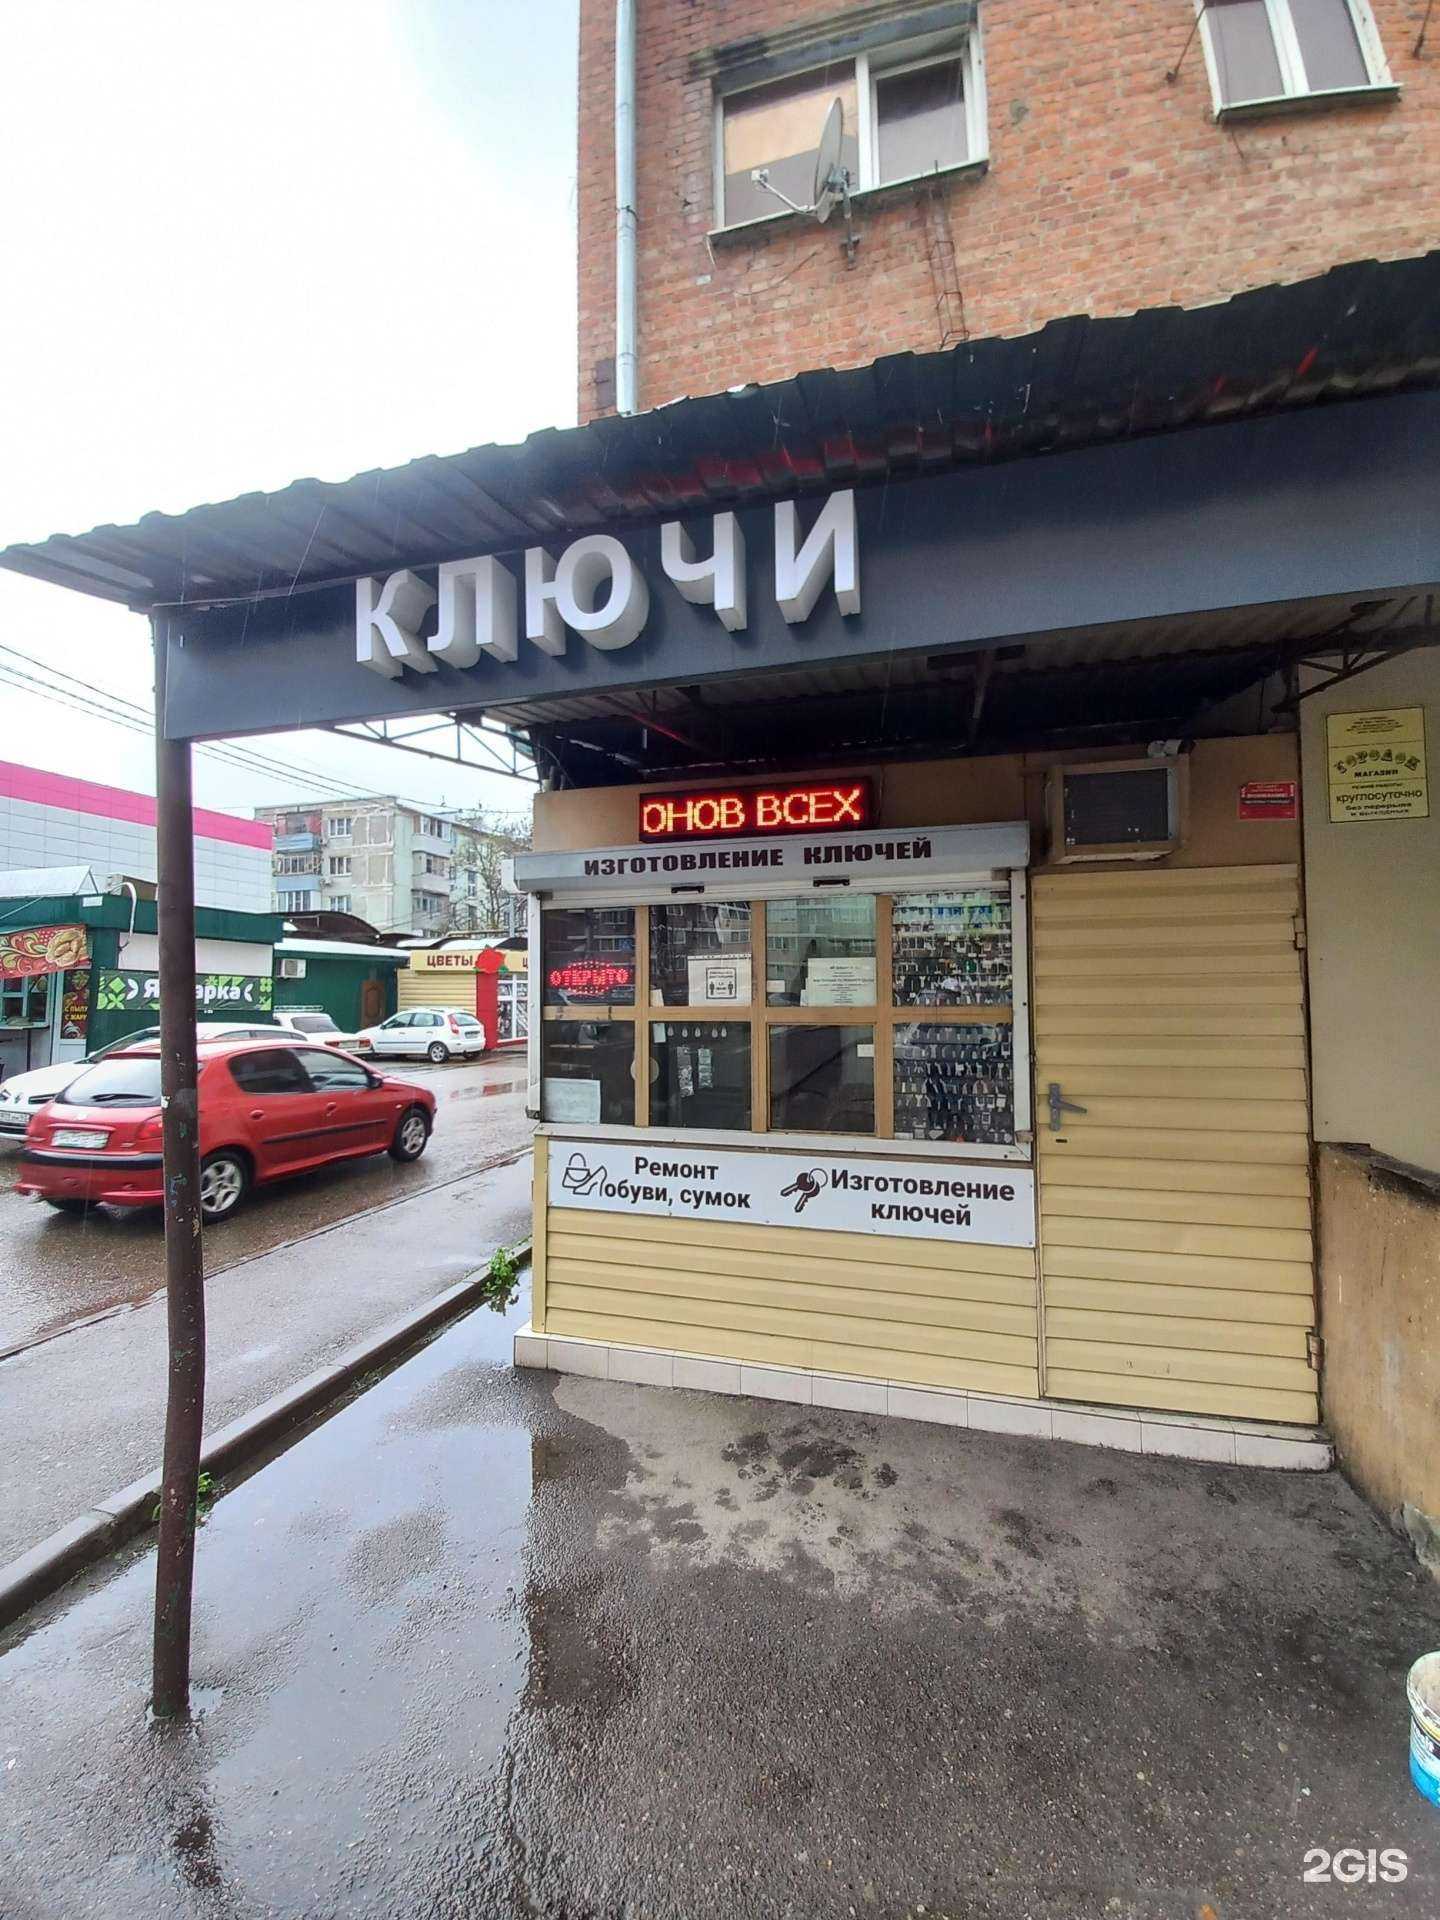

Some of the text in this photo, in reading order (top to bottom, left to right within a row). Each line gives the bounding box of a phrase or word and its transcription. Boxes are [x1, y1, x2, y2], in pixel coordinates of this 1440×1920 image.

[356, 489, 860, 678] КЛЮЧИ
[643, 789, 861, 833] ОНОВ ВСЕХ
[584, 837, 933, 876] ИЗГОТОВЛЕНИЕ КЛЮЧЕЙ
[426, 955, 473, 968] ЦВЕТЫ
[143, 978, 241, 1005] Яарка
[550, 969, 629, 987] ОТКРЫТО
[634, 1156, 719, 1180] Ремонт
[604, 1178, 751, 1209] обуви, сумок
[831, 1168, 1015, 1201] Изготовление
[871, 1203, 971, 1226] ключей
